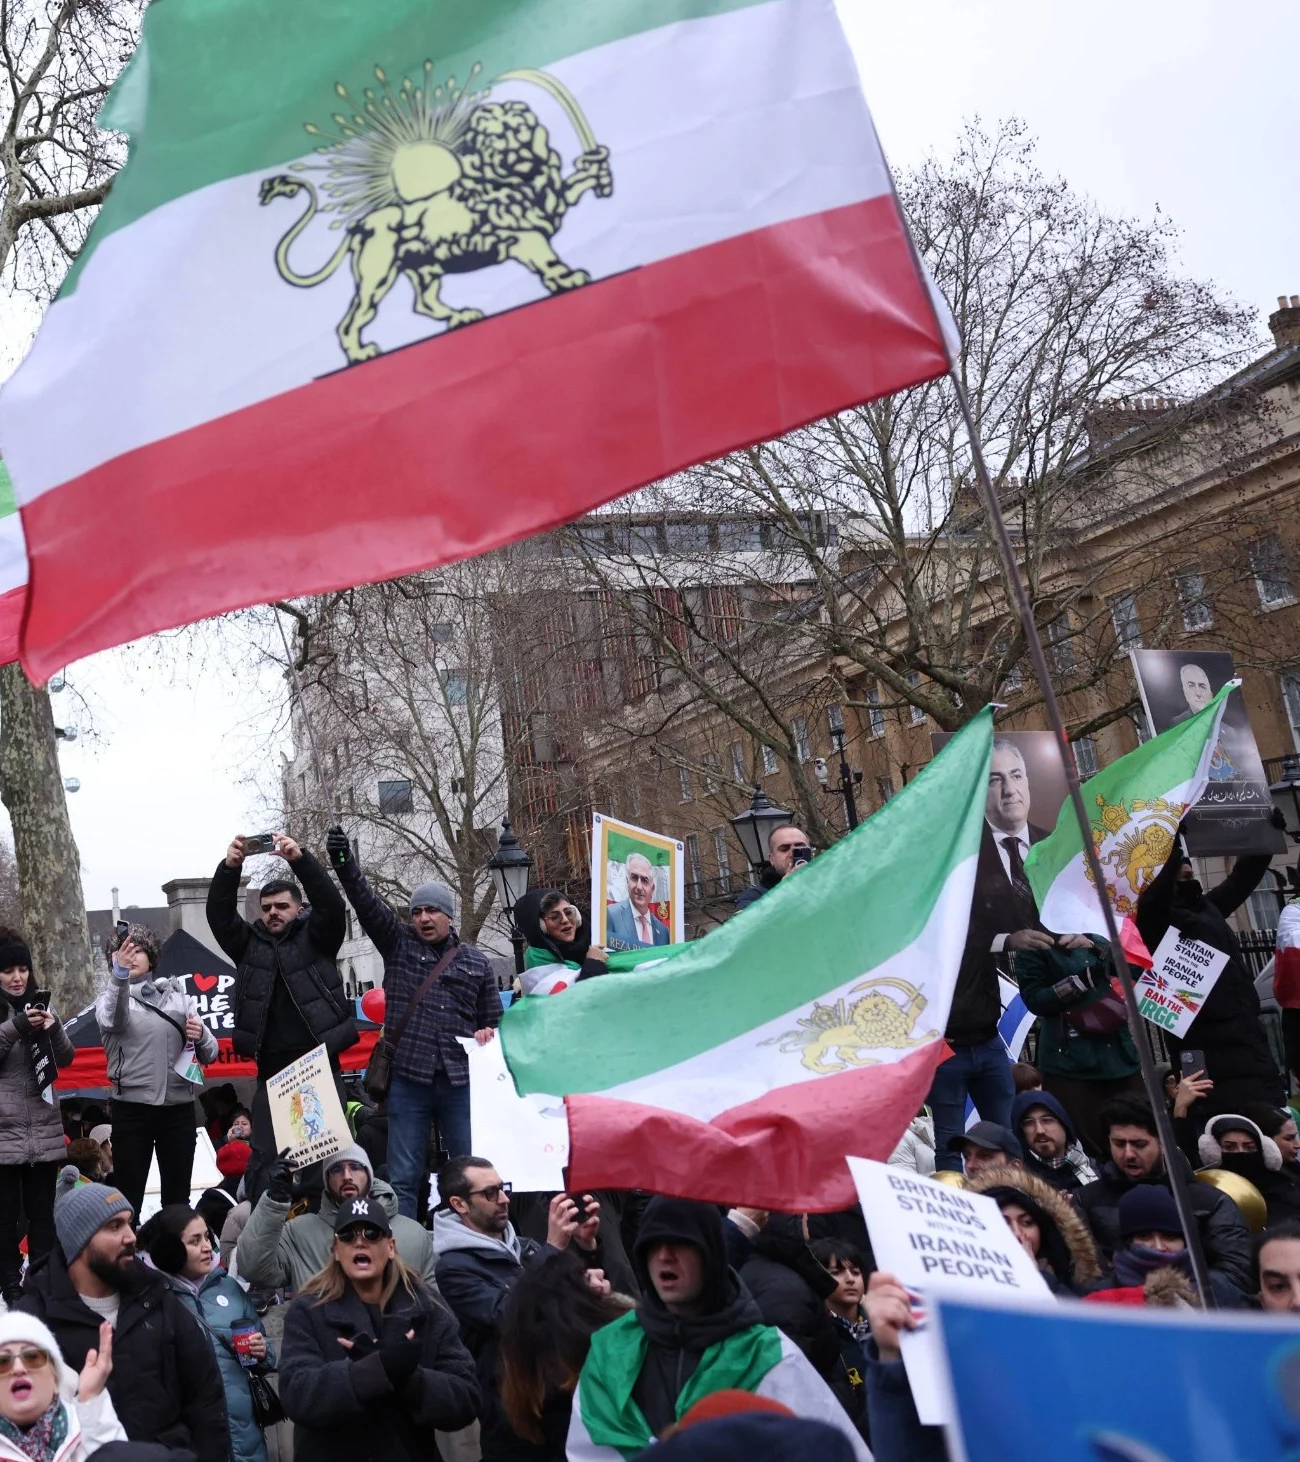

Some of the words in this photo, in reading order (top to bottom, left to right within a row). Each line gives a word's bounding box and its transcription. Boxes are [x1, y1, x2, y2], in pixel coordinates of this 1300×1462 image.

[610, 937, 630, 951] REZA
[1174, 944, 1210, 967] STANDS
[1179, 938, 1215, 960] BRITAIN
[1165, 957, 1204, 982] IRANIAN
[1178, 955, 1190, 964] WITH
[1162, 965, 1198, 988] PEOPLE
[184, 994, 230, 1012] HE
[1139, 997, 1179, 1030] IRGC
[1144, 988, 1167, 1006] BAN
[1167, 1000, 1184, 1015] THE
[299, 1048, 324, 1067] LIONS
[278, 1082, 300, 1099] PERSIA
[302, 1069, 322, 1082] AGAIN
[280, 1076, 297, 1089] MAKE
[298, 1065, 314, 1077] IRAN
[288, 1149, 309, 1160] MAKE
[311, 1136, 339, 1151] ISRAEL
[316, 1146, 339, 1160] AGAIN
[886, 1174, 976, 1213] BRITAIN
[896, 1194, 987, 1231] STANDS
[925, 1219, 953, 1232] WITH
[957, 1225, 977, 1239] THE
[908, 1232, 1013, 1269] IRANIAN
[920, 1255, 1021, 1288] PEOPLE
